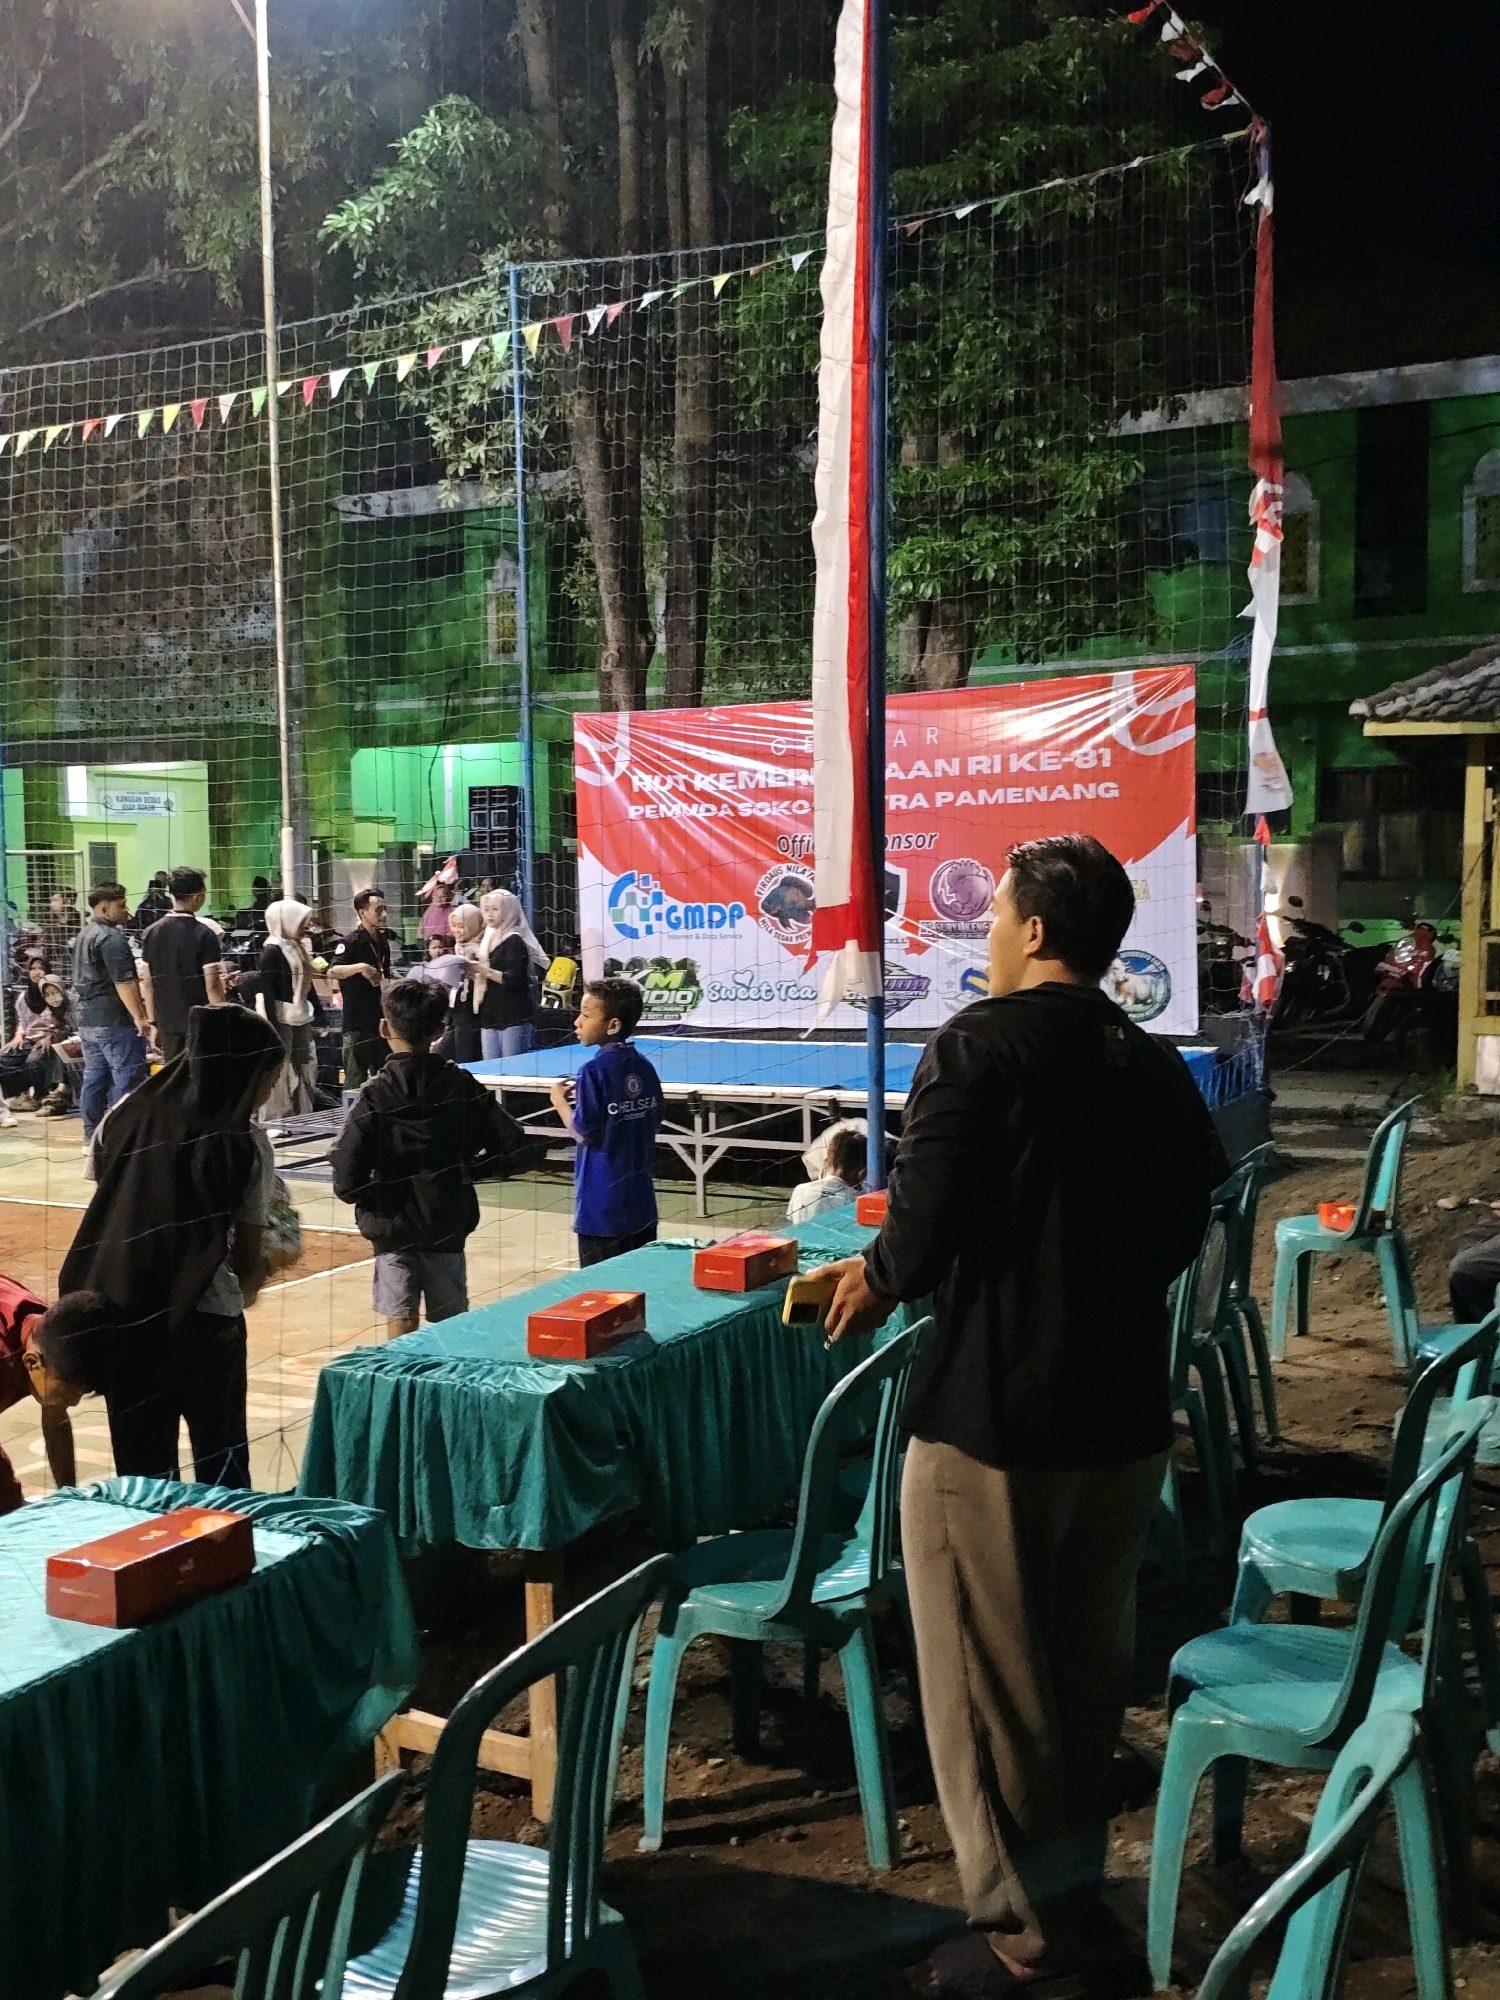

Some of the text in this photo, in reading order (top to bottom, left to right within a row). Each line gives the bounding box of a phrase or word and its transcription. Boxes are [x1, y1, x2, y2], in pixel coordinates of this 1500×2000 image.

[631, 747, 1112, 792] HUT KEMERAAN RI KE-81
[628, 803, 736, 820] PEMUDA
[936, 782, 1119, 807] PAMENANG
[756, 865, 784, 896] FIRDAUS
[665, 903, 745, 930] GMDP
[719, 932, 743, 940] Service
[707, 980, 818, 1003] Sweet Tea
[607, 1096, 658, 1115] CHELSEA
